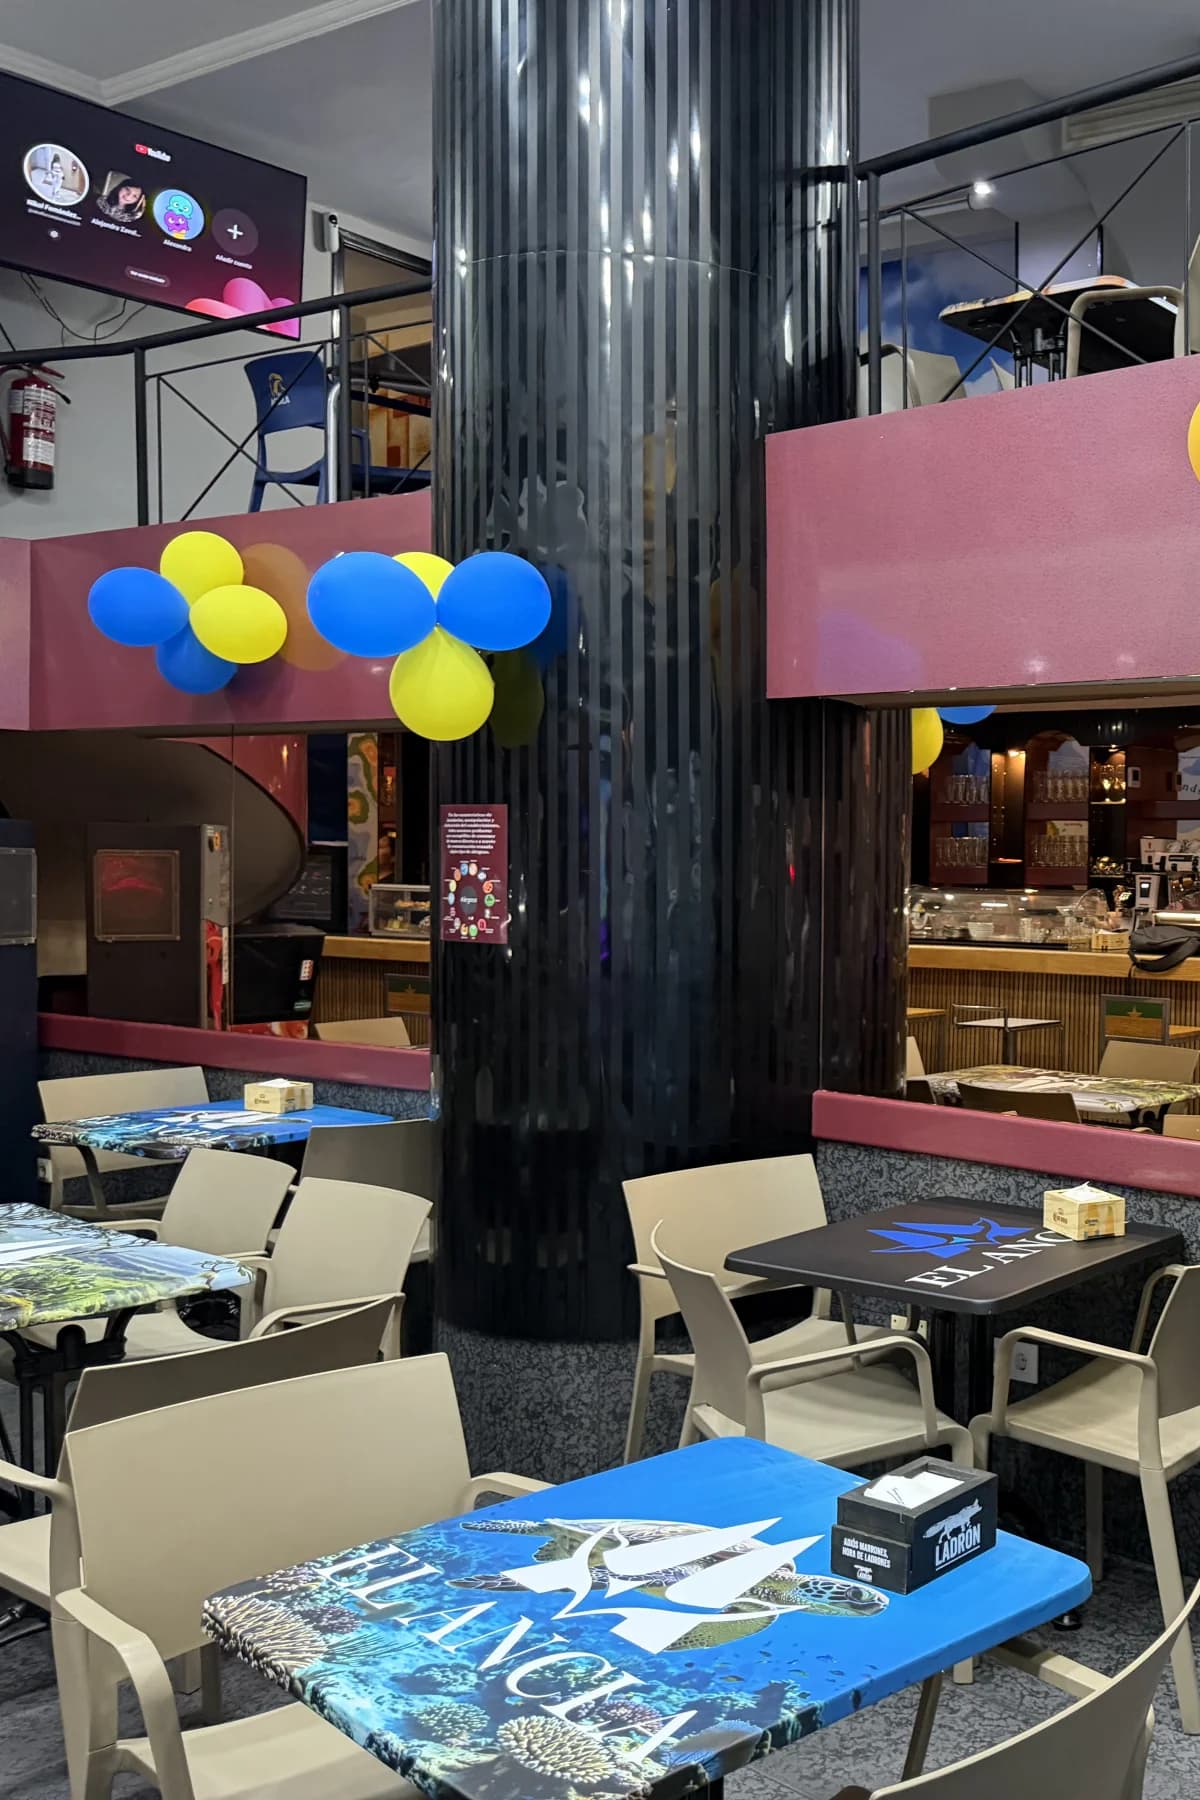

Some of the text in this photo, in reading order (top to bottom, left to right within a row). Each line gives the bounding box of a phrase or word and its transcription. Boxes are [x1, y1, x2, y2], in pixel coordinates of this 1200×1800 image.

[147, 148, 171, 162] YouTube
[905, 1231, 1073, 1288] EL ANC
[842, 1546, 891, 1569] HORA DE LADRONES
[844, 1537, 859, 1549] ADIÓS
[936, 1523, 981, 1567] LADRÓN
[316, 1544, 444, 1610] EL
[396, 1601, 698, 1764] ANCLA
